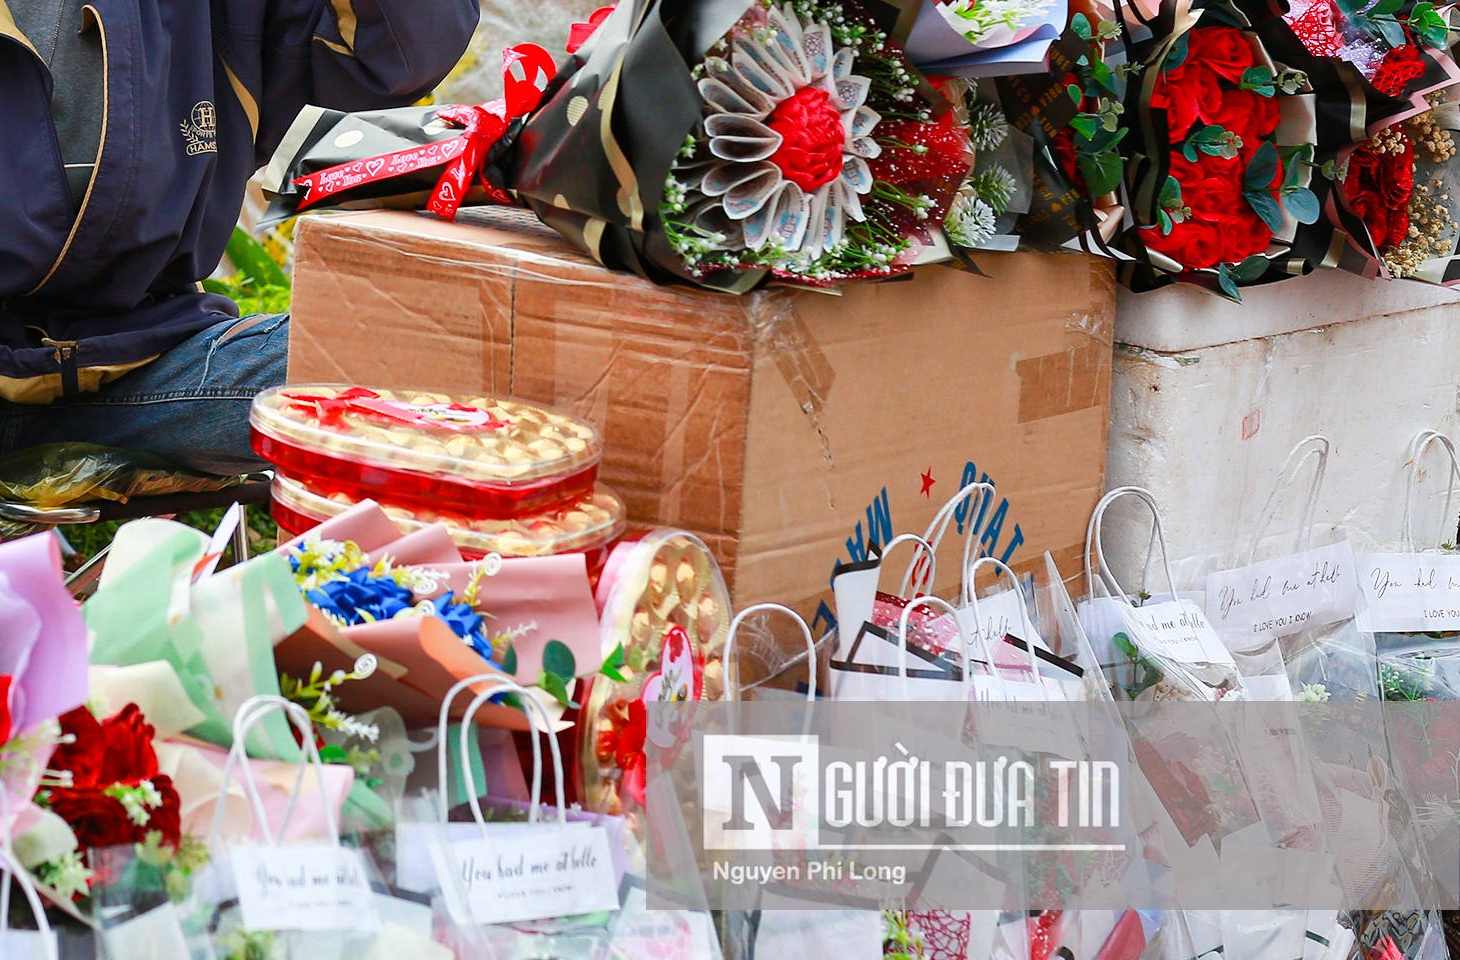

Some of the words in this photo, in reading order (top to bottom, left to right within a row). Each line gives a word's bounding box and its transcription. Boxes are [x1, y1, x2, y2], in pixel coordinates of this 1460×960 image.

[319, 169, 345, 186] Love
[342, 174, 362, 187] You
[1371, 567, 1403, 599] You
[1218, 585, 1243, 620] You
[1259, 620, 1273, 632] LOVE
[1275, 617, 1287, 628] YOU
[1294, 611, 1312, 623] KNOW
[1429, 609, 1445, 619] LOVE
[461, 856, 492, 892] You
[496, 853, 524, 879] had
[530, 862, 549, 874] me
